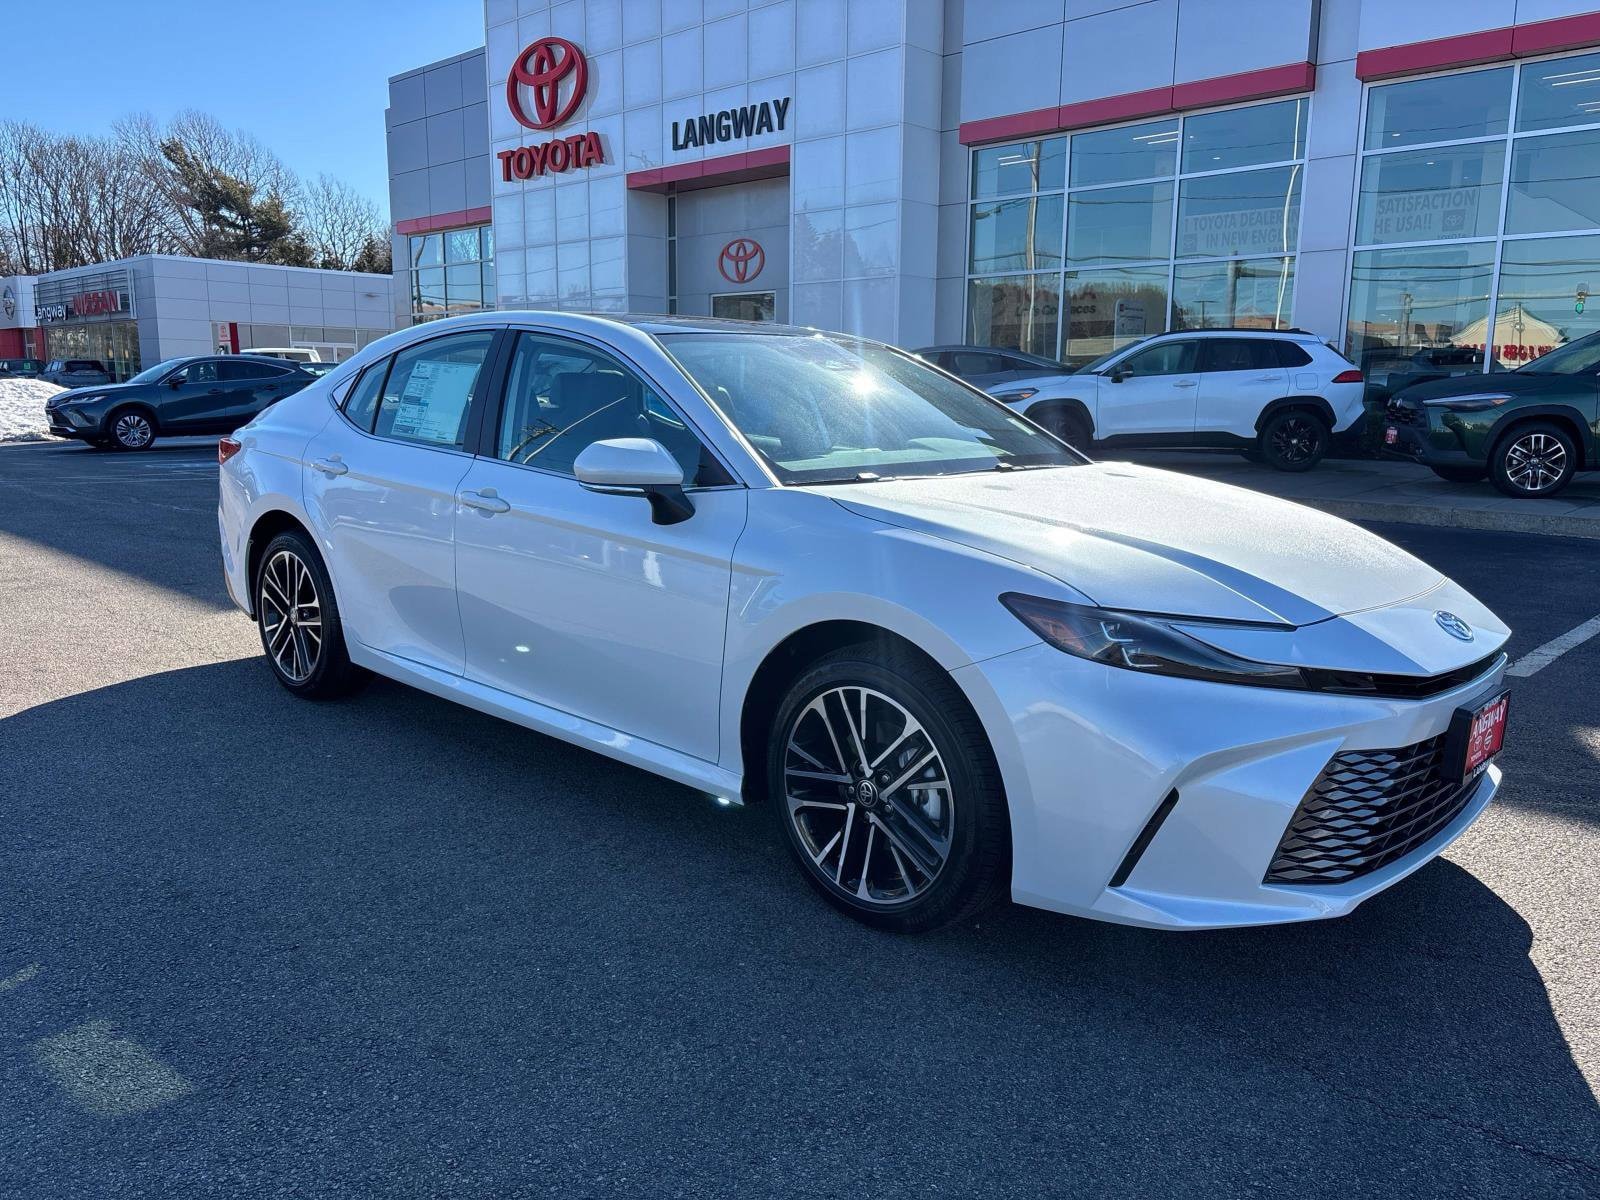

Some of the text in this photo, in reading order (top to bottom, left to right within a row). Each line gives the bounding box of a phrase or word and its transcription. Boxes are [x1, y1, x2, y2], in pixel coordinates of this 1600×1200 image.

[671, 97, 790, 151] LANGWAY
[497, 131, 605, 182] TOYOTA
[1378, 189, 1476, 215] SATISFACTION
[1194, 214, 1236, 231] TOYOTA
[1396, 213, 1432, 232] USA!!
[1221, 231, 1248, 246] NEW
[35, 290, 121, 322] Langway NISSAN
